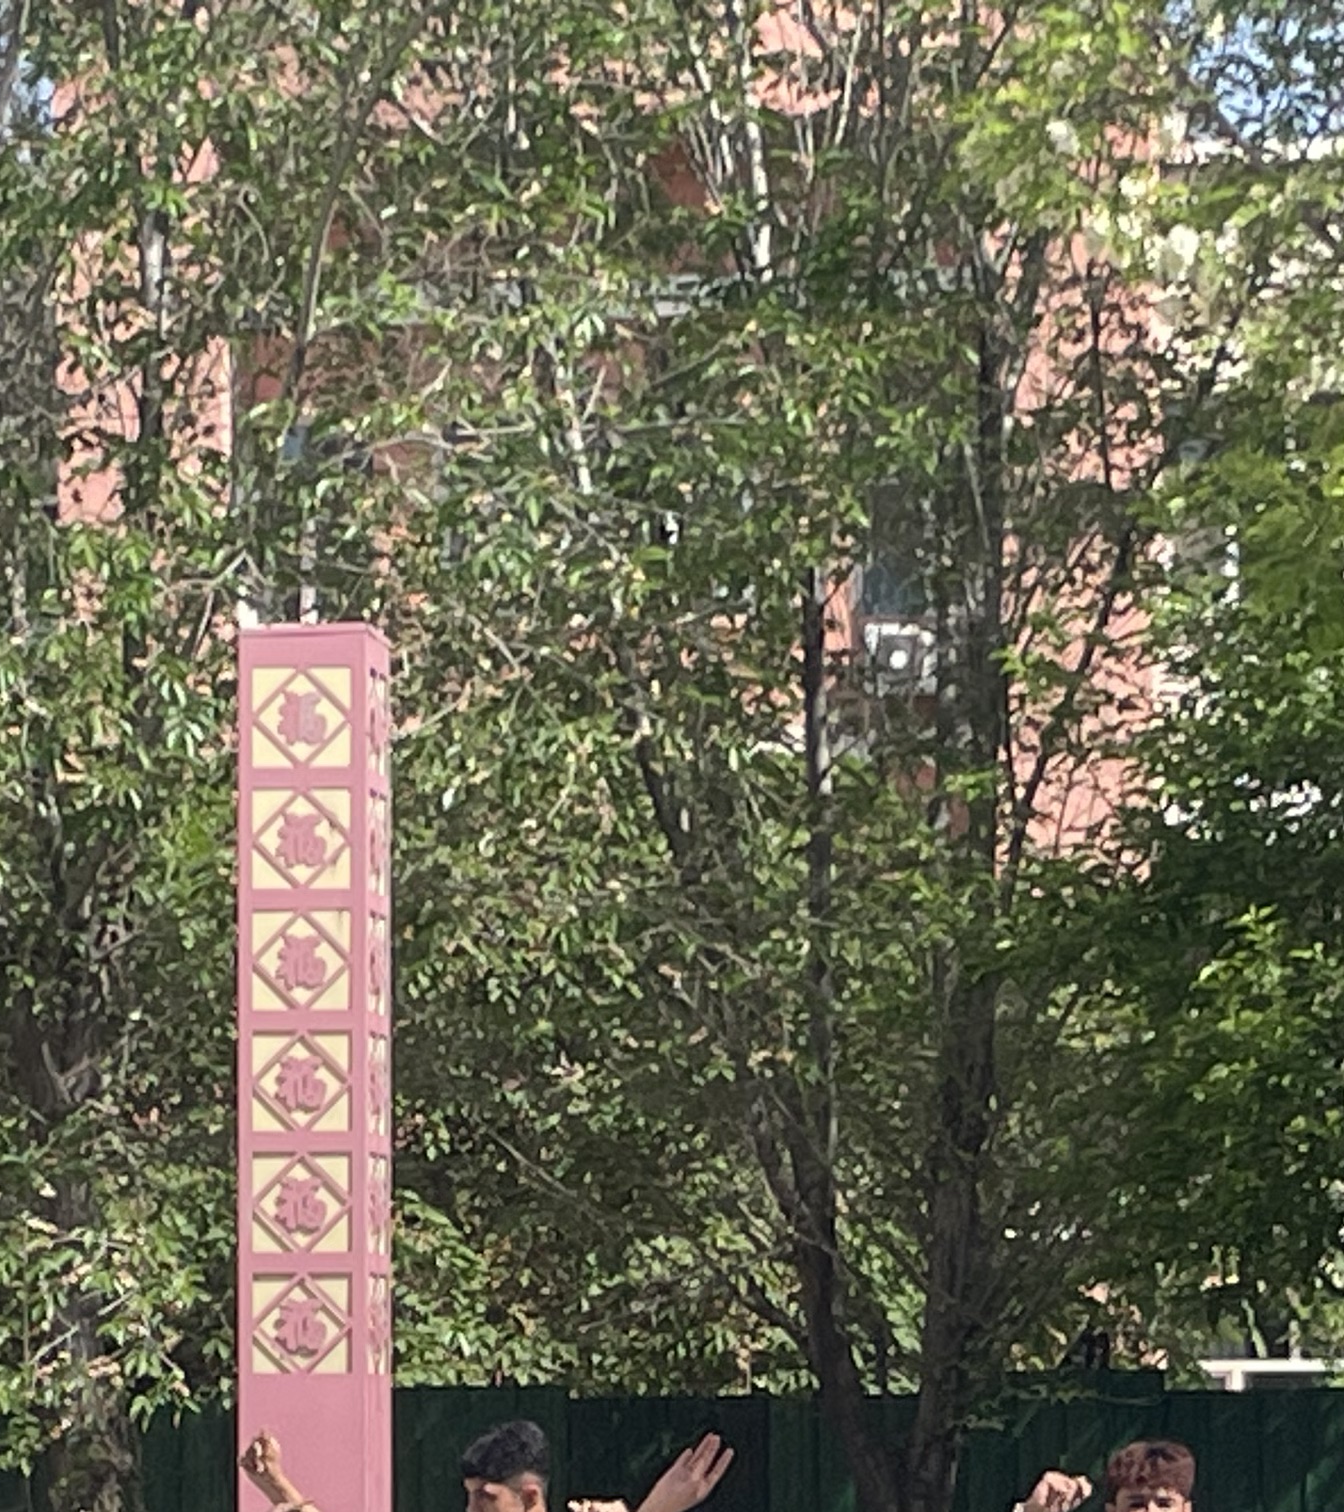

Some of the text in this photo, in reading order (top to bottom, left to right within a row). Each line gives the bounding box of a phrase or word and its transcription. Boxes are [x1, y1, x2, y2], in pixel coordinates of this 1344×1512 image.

[277, 690, 327, 746] 福
[275, 811, 327, 868] 福
[275, 933, 327, 990] 福
[275, 1055, 326, 1113] 福
[275, 1176, 326, 1234] 福
[274, 1298, 326, 1356] 福
